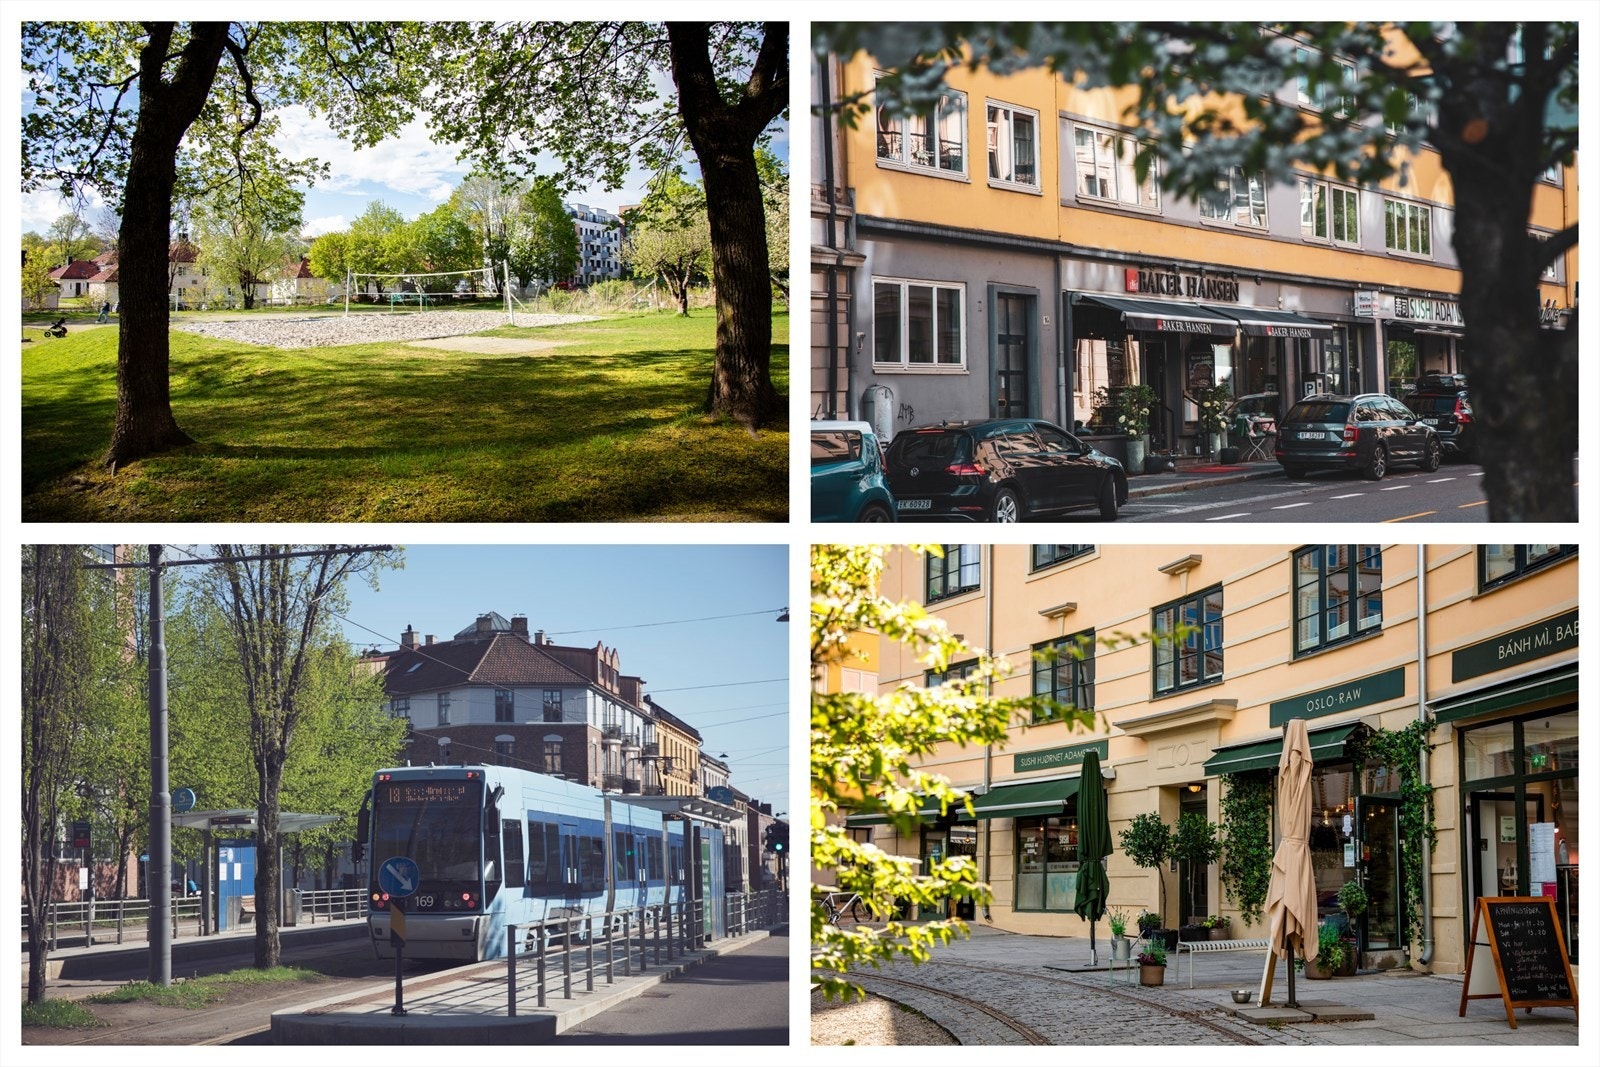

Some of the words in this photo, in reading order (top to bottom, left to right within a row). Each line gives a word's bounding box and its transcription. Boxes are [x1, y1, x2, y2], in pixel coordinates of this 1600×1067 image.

[1138, 271, 1184, 296] BAKER
[1186, 276, 1239, 301] HANSEN
[1409, 298, 1434, 320] SUSHI
[1163, 320, 1185, 332] BAKER
[1185, 322, 1212, 334] HANSEN
[1271, 327, 1288, 337] BAKER
[1290, 327, 1311, 338] HANSEN
[1307, 384, 1313, 394] P
[1498, 636, 1531, 660] BÁNH
[1534, 627, 1552, 649] MÌ,
[1020, 757, 1036, 767] SUSHI
[1037, 752, 1063, 764] HJØRNET
[414, 895, 434, 907] 169
